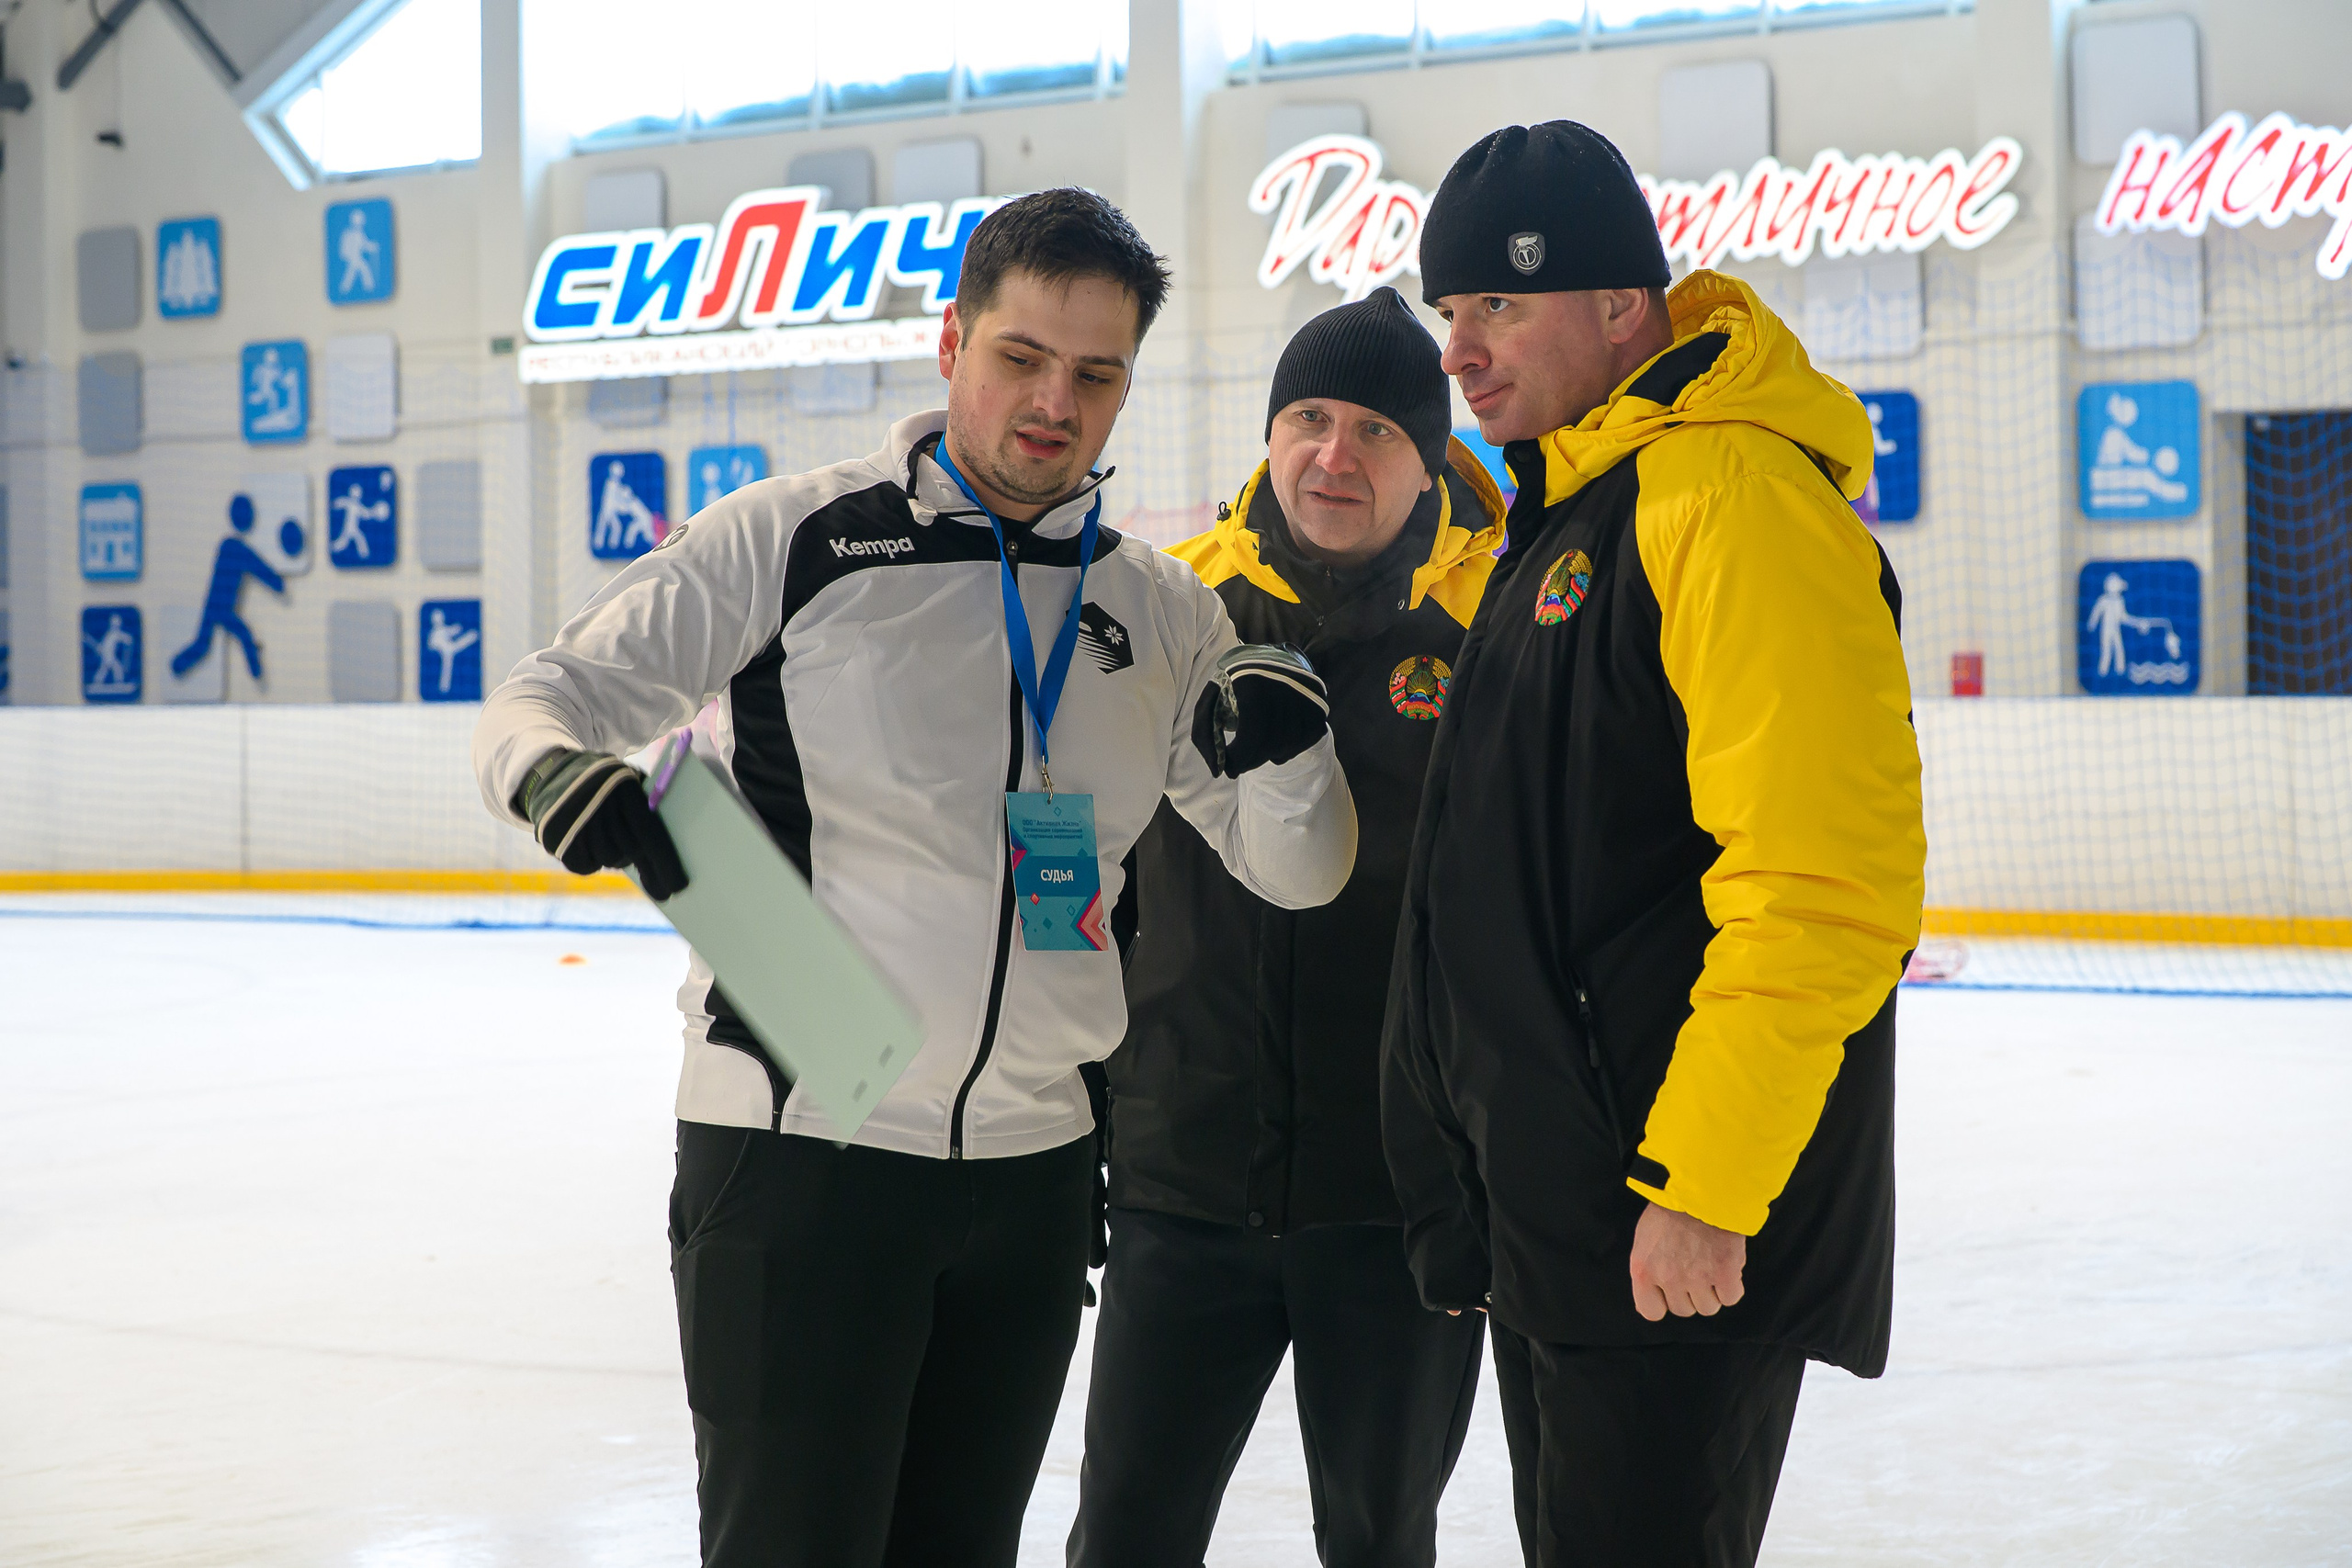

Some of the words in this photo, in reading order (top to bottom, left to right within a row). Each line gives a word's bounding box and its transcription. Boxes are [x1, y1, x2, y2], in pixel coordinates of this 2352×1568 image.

[1261, 146, 1420, 301] Дар
[1641, 149, 2014, 266] тличное
[534, 198, 985, 330] СИЛИЧ
[829, 536, 915, 558] Kempa
[1040, 869, 1074, 884] СУДЬЯ
